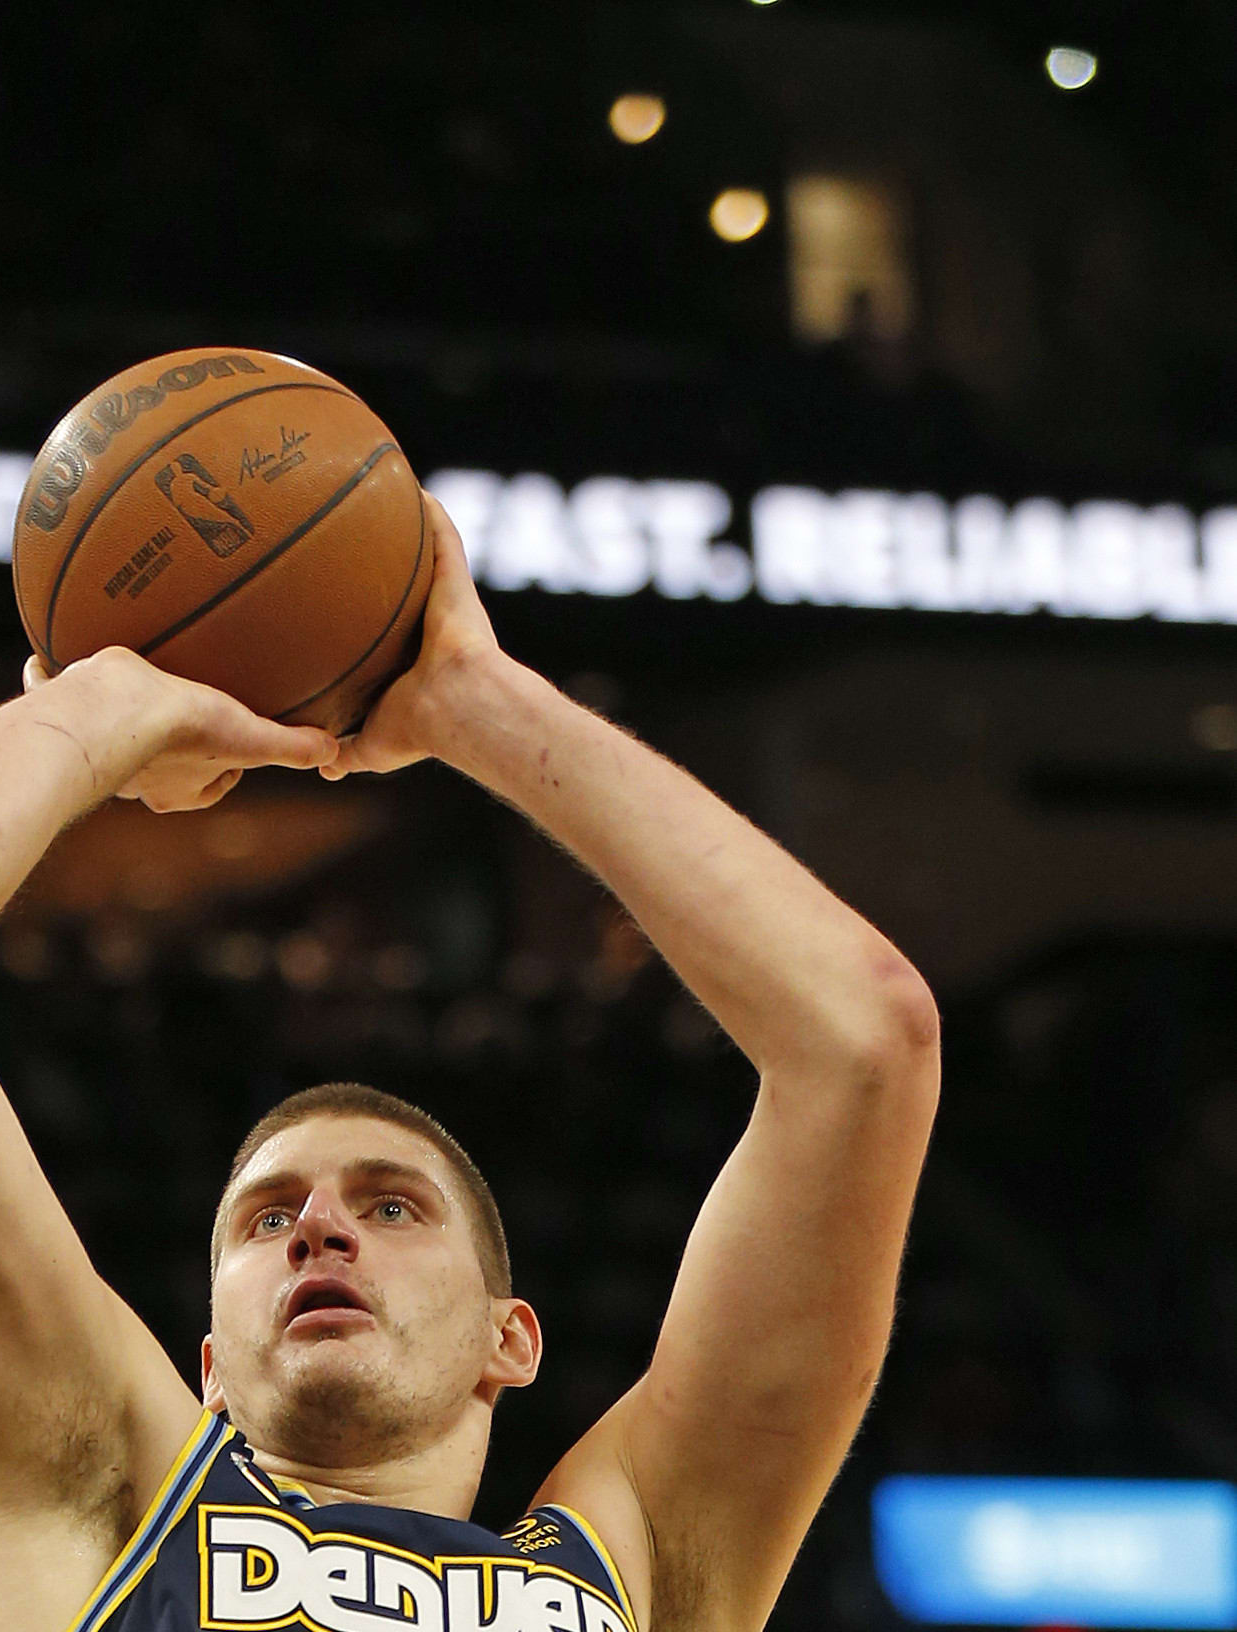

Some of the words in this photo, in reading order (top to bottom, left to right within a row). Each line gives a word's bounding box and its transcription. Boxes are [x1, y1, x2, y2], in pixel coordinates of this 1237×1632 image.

[25, 355, 265, 532] Wilson
[151, 525, 176, 550] BALL
[519, 1535, 562, 1554] nion
